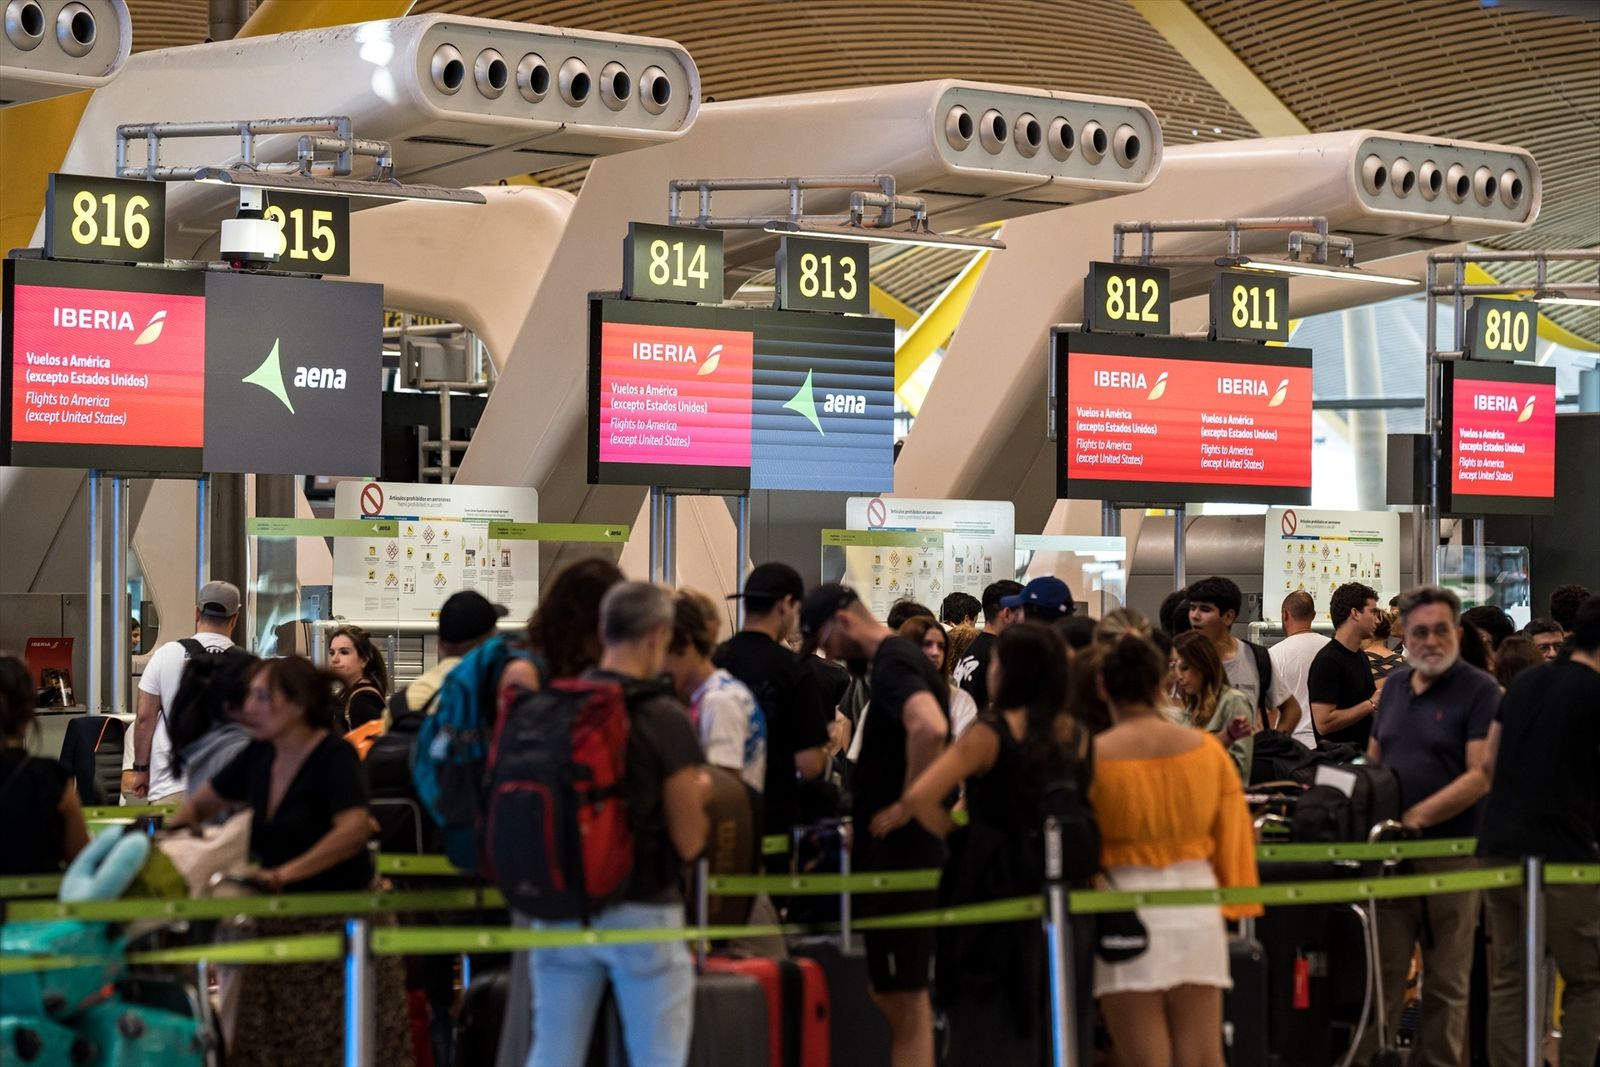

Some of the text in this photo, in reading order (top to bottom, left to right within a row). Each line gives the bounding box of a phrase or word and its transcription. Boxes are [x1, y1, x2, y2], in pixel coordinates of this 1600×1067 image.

[71, 190, 150, 249] 816
[649, 239, 709, 289] 814
[799, 253, 858, 300] 813
[1106, 275, 1159, 323] 812
[1231, 284, 1279, 330] 811
[53, 307, 134, 331] IBERIA
[1485, 308, 1530, 353] 810
[26, 352, 110, 368] Vuelos a América
[633, 342, 697, 363] IBERIA
[26, 369, 149, 389] (excepto Estados Unidos)
[294, 366, 347, 390] aena
[1094, 370, 1148, 390] IBERIA
[611, 382, 678, 397] Vuelos a América
[1217, 377, 1269, 396] IBERIA
[25, 391, 110, 408] Flights to America
[611, 398, 708, 414] (excepto Estados Unidos)
[823, 393, 866, 414] aena
[1474, 394, 1518, 412] IBERIA
[25, 408, 127, 426] (except United States)
[1076, 406, 1132, 419] Vuelos a América
[1201, 413, 1254, 426] Vuelos a América
[610, 418, 677, 432] Flights to America
[1076, 422, 1158, 435] (excepto Estados Unidos)
[610, 434, 691, 448] (except United States)
[1201, 427, 1278, 441] (excepto Estados Unidos)
[1459, 427, 1505, 440] Vuelos a América
[1076, 438, 1132, 451] Flights to America
[1201, 444, 1254, 457] Flights to America
[1459, 440, 1525, 454] (excepto Estados Unidos)
[1076, 452, 1143, 465] (except United States)
[1201, 458, 1264, 471] (except United States)
[1459, 456, 1504, 468] Flights to America
[1459, 470, 1513, 482] (except United States)
